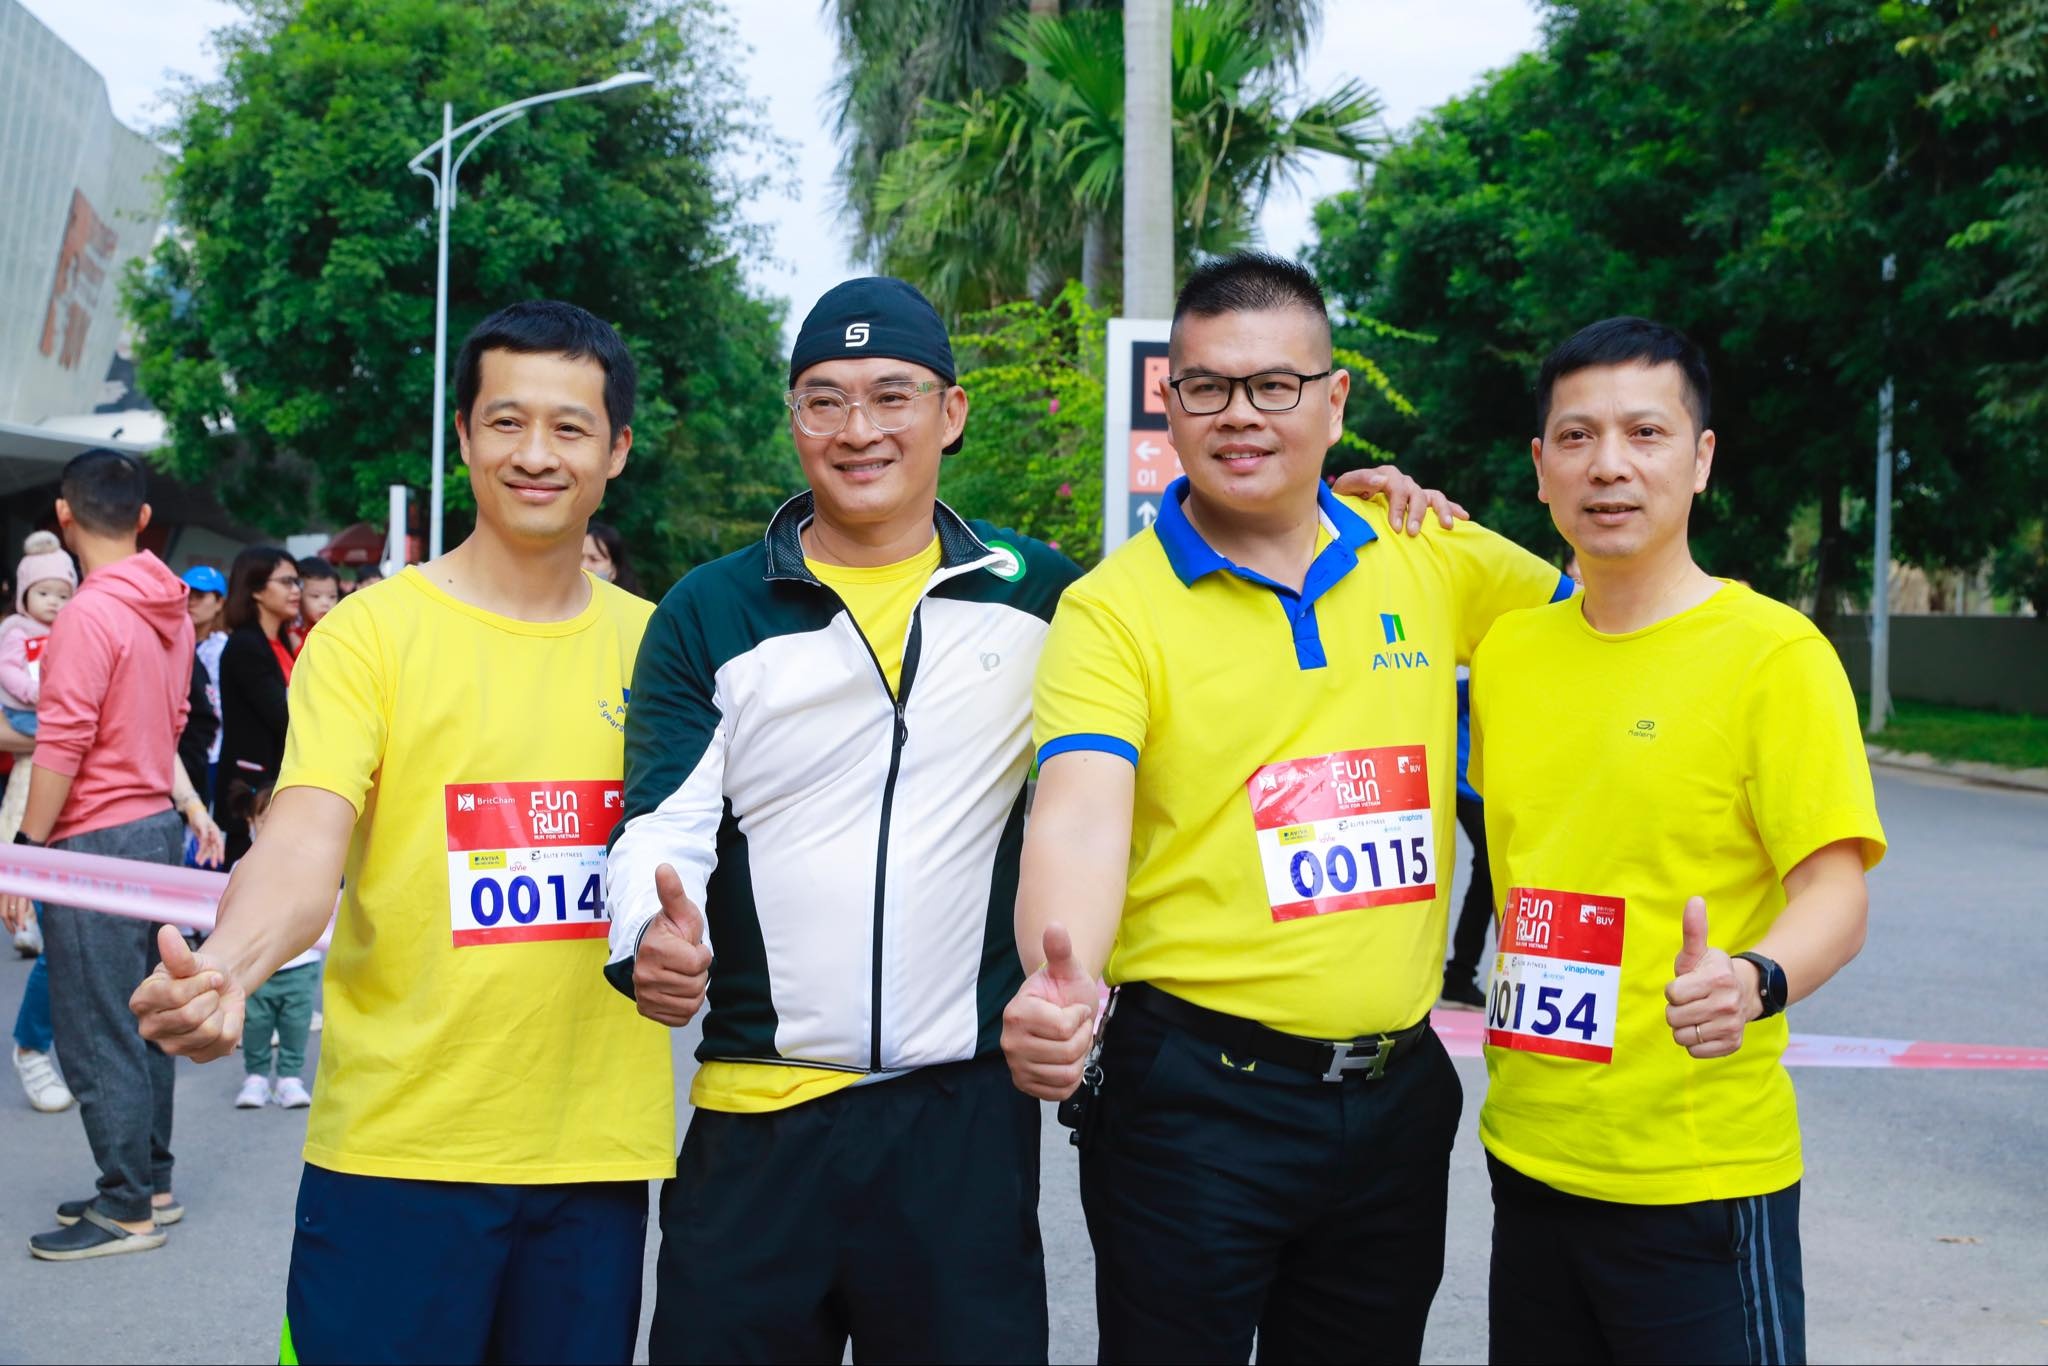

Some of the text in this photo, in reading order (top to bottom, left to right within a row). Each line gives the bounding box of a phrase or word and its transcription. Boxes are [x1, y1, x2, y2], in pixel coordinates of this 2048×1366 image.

[1372, 651, 1429, 671] AVIVA
[600, 710, 625, 732] years
[1331, 758, 1377, 780] FUN
[477, 796, 515, 806] BritCham
[530, 790, 578, 810] FUN
[1336, 780, 1380, 804] RUN
[533, 811, 580, 834] RUN
[1290, 837, 1428, 898] 00115
[470, 873, 608, 926] 0014
[1519, 897, 1553, 920] FUN
[1516, 920, 1550, 944] RUN
[1596, 916, 1615, 926] BUV
[1563, 964, 1605, 977] vinaphone
[1488, 979, 1598, 1041] 00154
